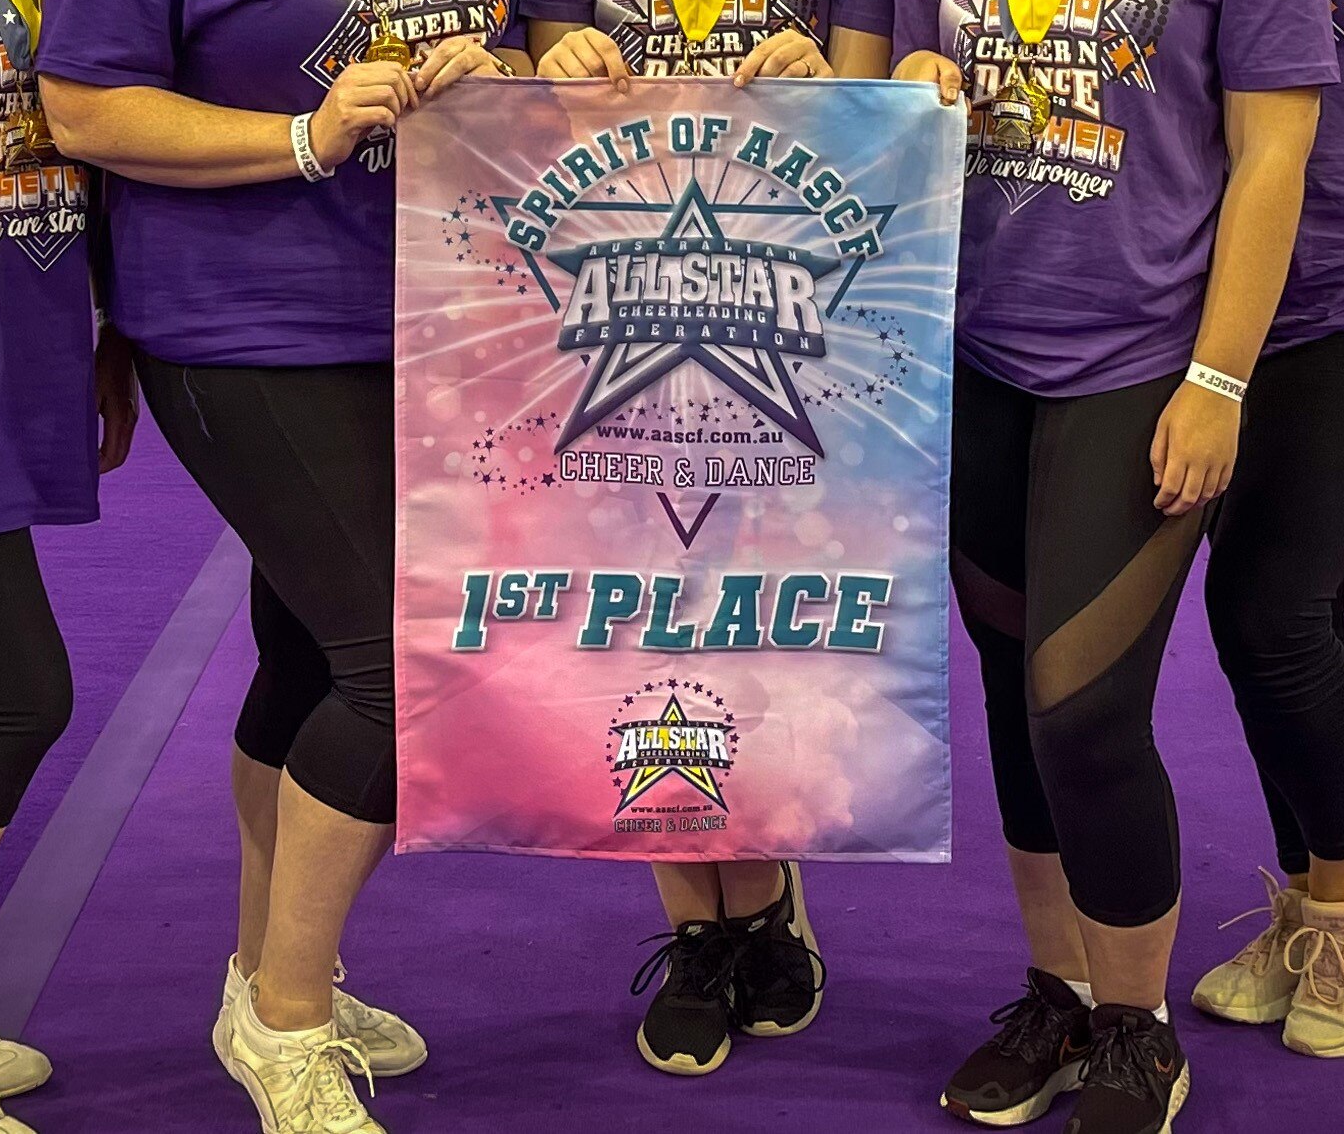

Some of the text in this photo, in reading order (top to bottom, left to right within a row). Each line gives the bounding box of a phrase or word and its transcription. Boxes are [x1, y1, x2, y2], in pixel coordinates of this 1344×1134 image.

[469, 5, 486, 30] N
[646, 31, 743, 60] CHEER
[1079, 40, 1098, 66] N
[358, 138, 396, 173] W
[506, 113, 884, 261] SPIRIT OF AASCF
[991, 156, 1027, 180] are
[1028, 155, 1114, 202] stronger
[8, 215, 45, 237] are
[49, 207, 86, 234] stro
[589, 240, 798, 261] AUSTRALIAN
[618, 304, 767, 323] CHEERLEADING
[575, 323, 810, 349] FEDERATION
[597, 425, 784, 444] www.aascf.com.au
[560, 450, 816, 487] CHEER & DANCE
[452, 568, 896, 653] 1ST PLACE
[614, 816, 728, 833] CHEER & DANCE
